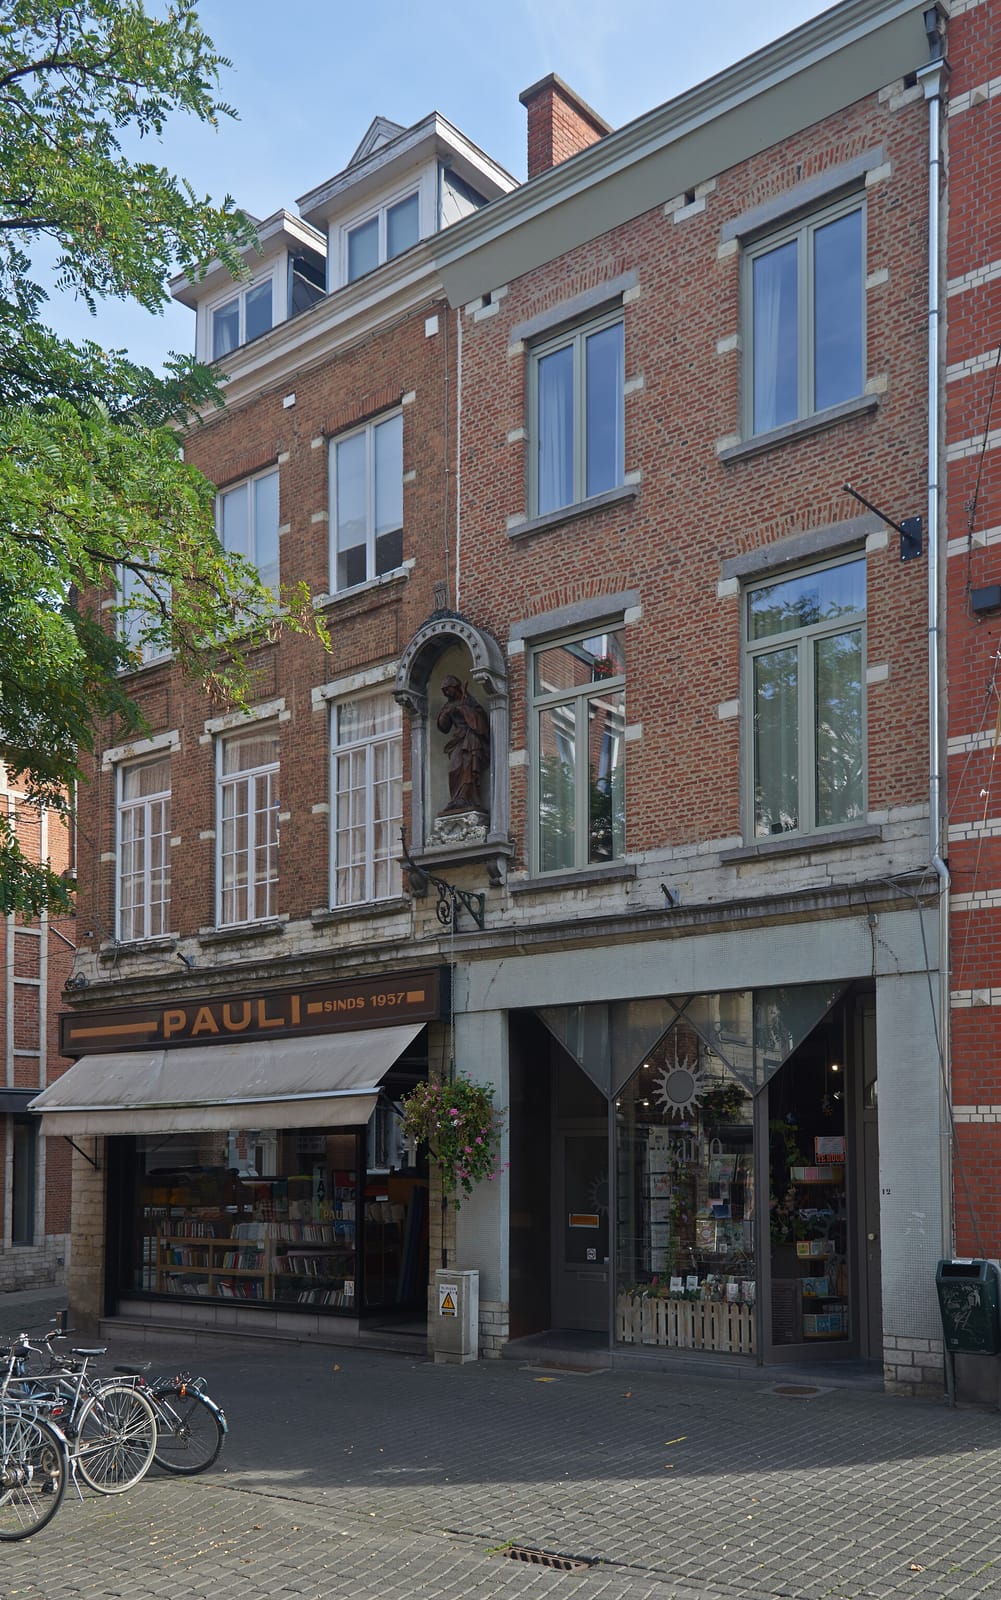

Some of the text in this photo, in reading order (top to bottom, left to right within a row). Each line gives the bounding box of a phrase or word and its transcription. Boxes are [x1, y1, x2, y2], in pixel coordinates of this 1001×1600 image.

[163, 995, 300, 1039] PAULI
[324, 992, 405, 1012] SINDS 1957
